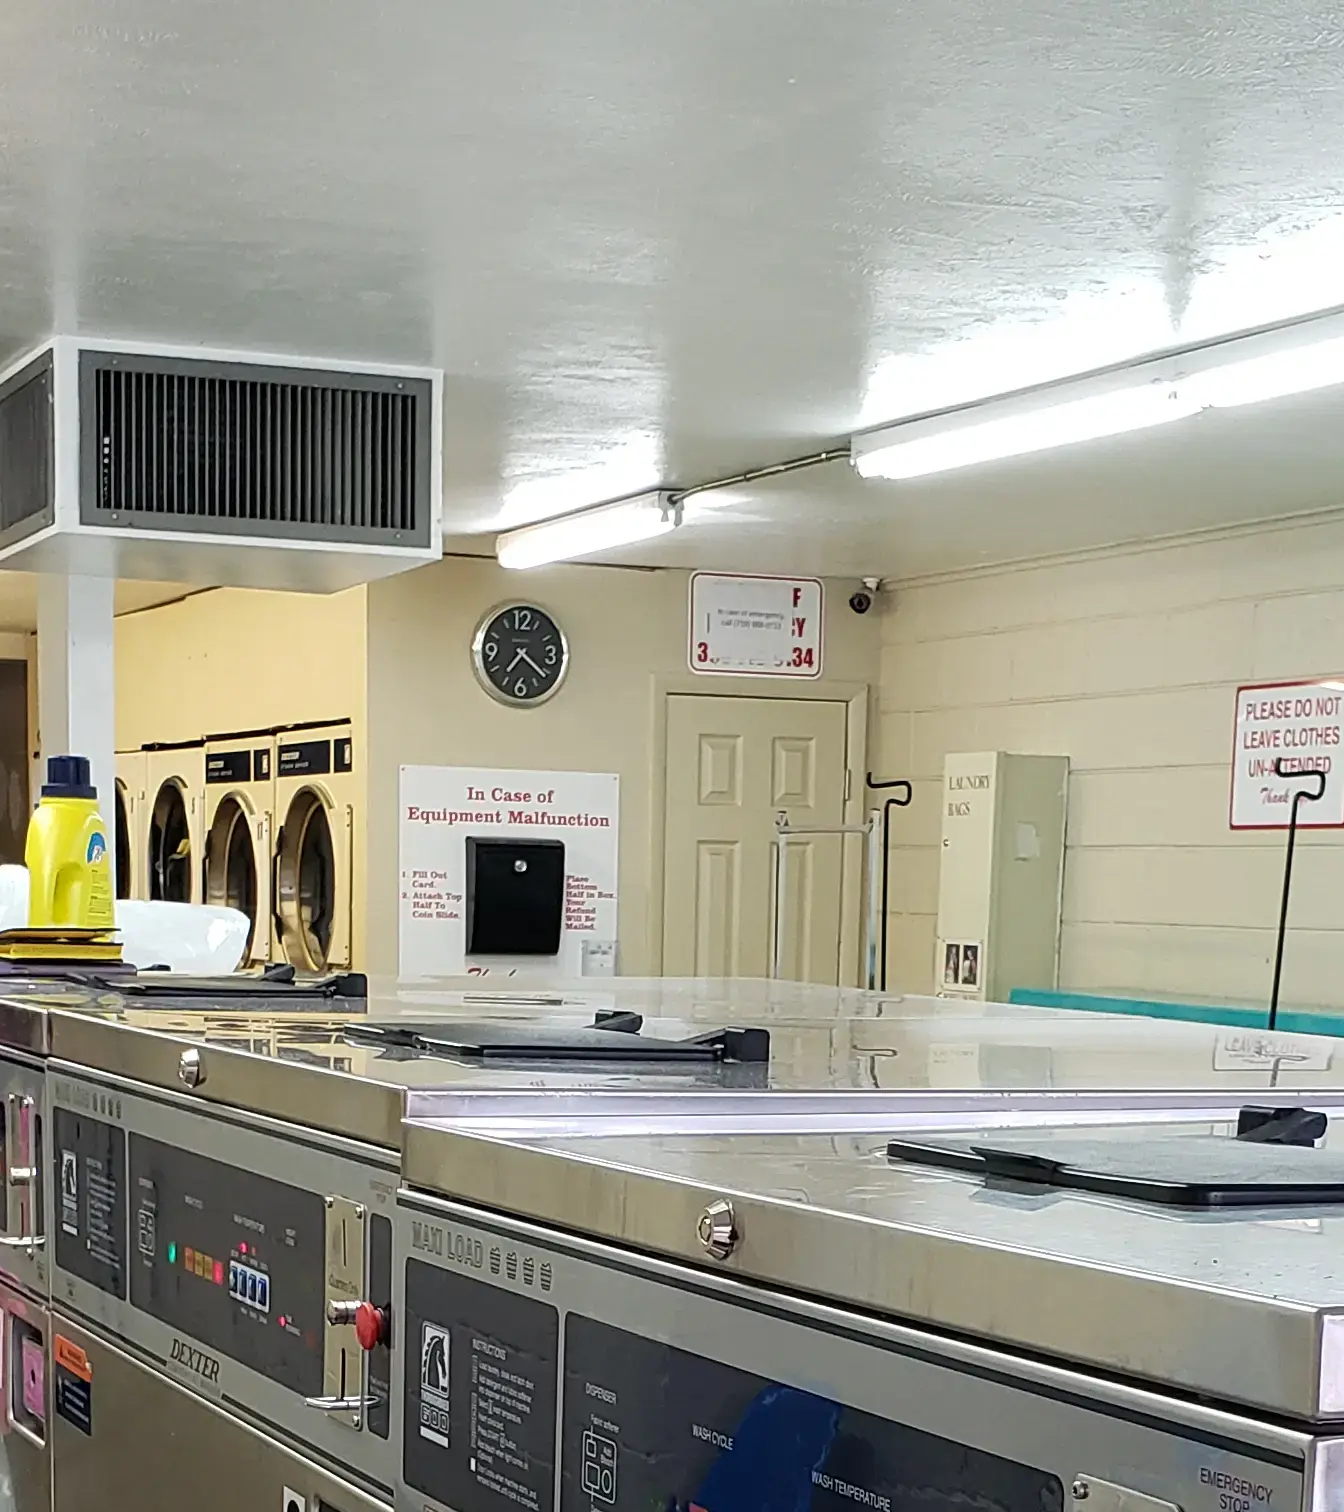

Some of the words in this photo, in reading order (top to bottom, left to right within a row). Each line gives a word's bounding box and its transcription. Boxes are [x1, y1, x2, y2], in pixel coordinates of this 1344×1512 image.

[513, 610, 532, 631] 12
[485, 642, 498, 662] 9
[544, 645, 557, 665] 3
[514, 677, 527, 697] 6
[1246, 700, 1293, 722] PLEASE
[1294, 698, 1313, 718] DO
[1315, 697, 1342, 716] NOT
[1243, 730, 1282, 750] LEAVE
[1283, 726, 1341, 748] CLOTHES
[1248, 756, 1332, 778] UN-ATENDED
[466, 787, 485, 801] In
[491, 787, 532, 803] Case
[537, 790, 555, 804] of
[407, 806, 502, 825] Equipment
[507, 810, 611, 828] Malfunction
[170, 1338, 221, 1384] DEXTER
[692, 1423, 712, 1442] WASH
[712, 1431, 735, 1451] CYCLE
[811, 1470, 833, 1491] WASH
[1200, 1467, 1273, 1503] EMERGENCY
